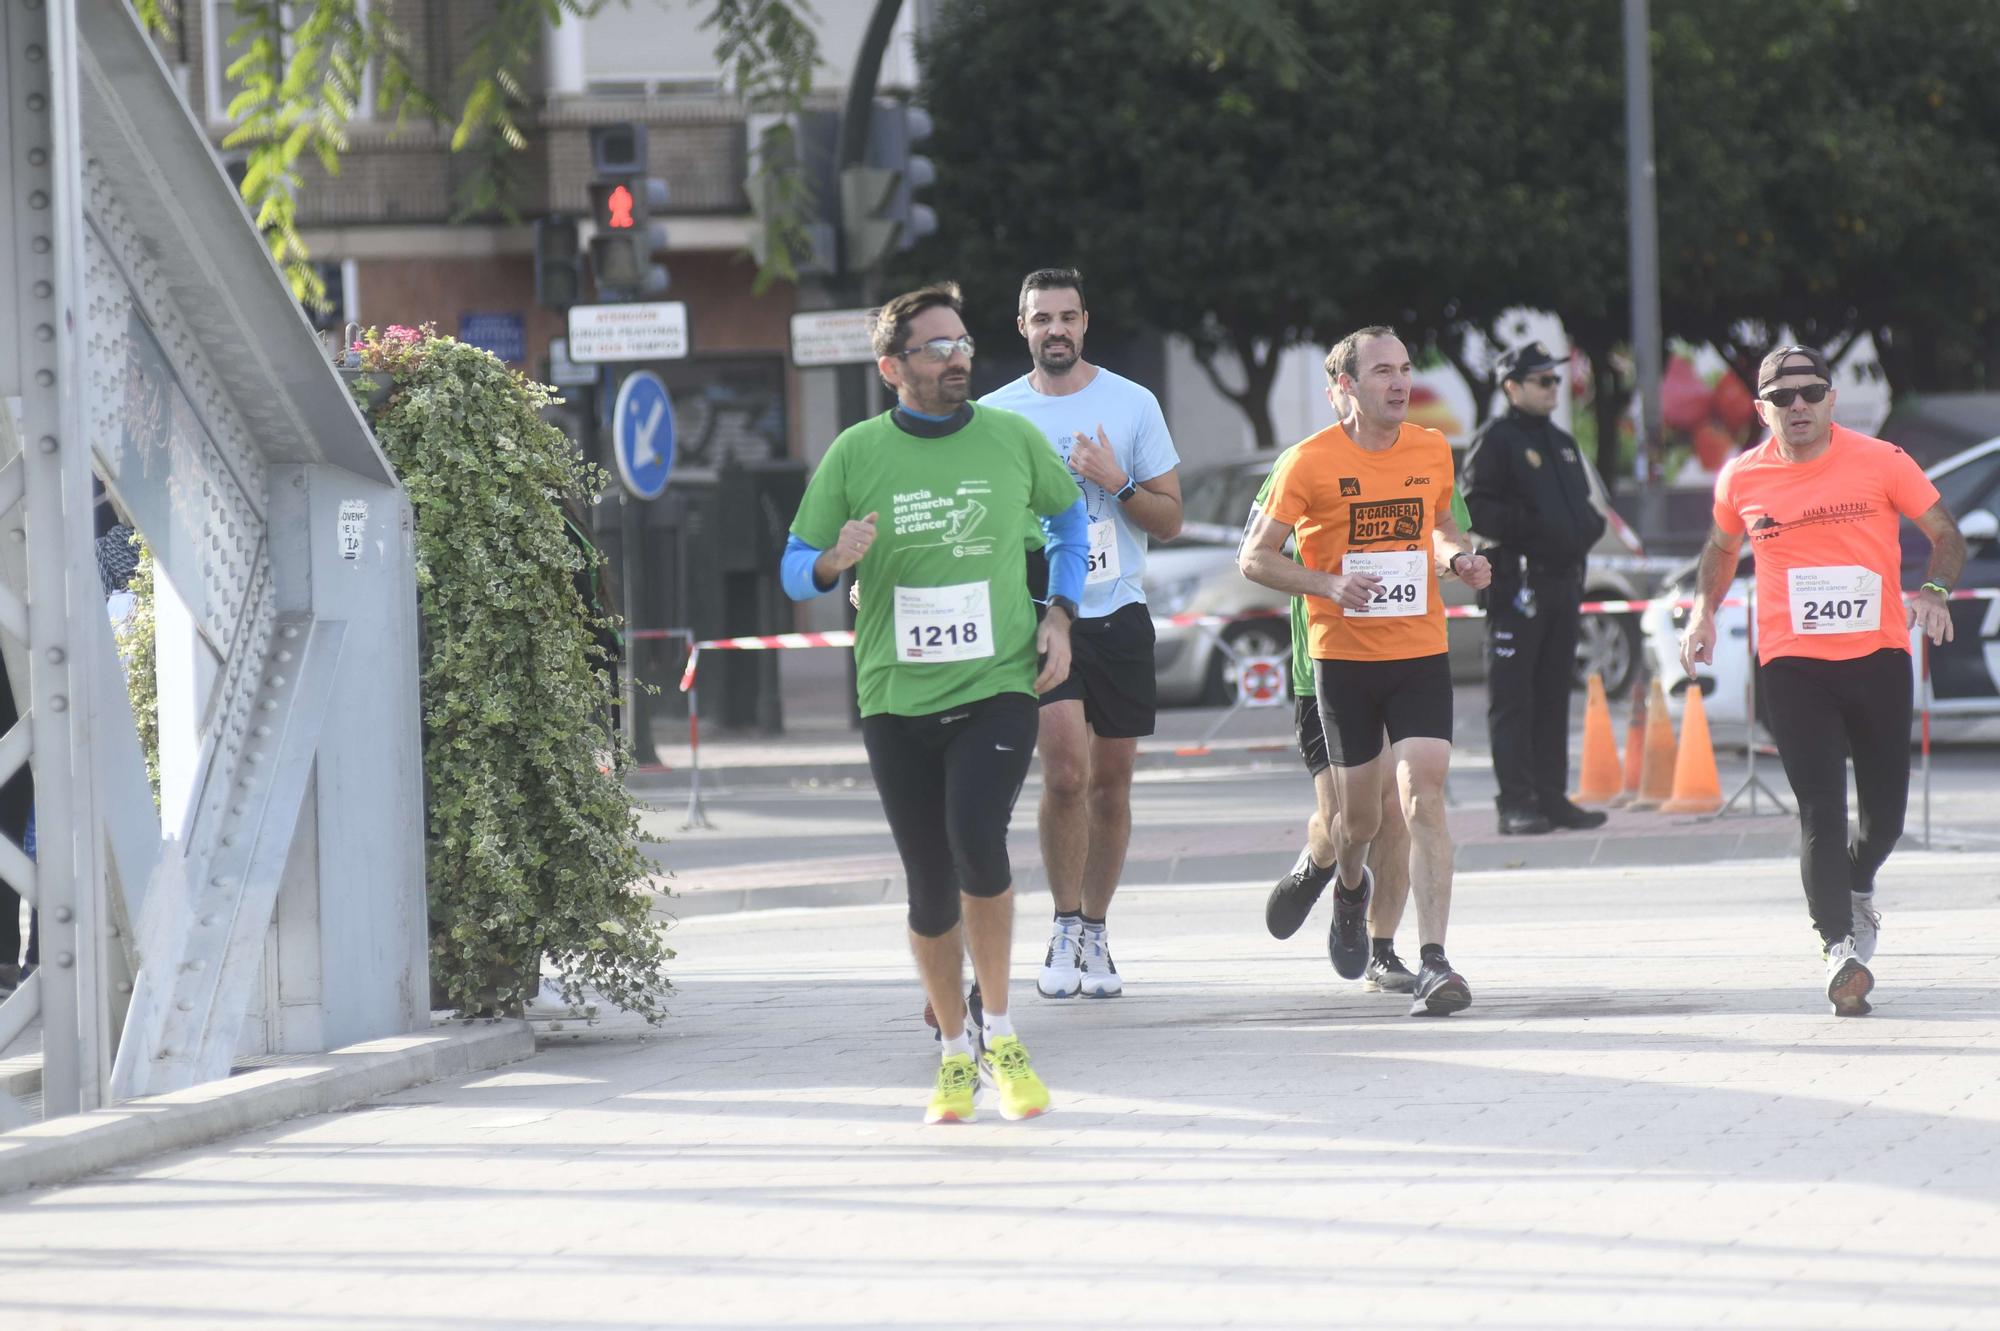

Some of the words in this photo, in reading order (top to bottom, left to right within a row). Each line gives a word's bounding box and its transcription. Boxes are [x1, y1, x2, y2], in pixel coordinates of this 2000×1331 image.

[893, 489, 931, 504] Murcia
[894, 504, 908, 514] en
[910, 497, 954, 511] marcha
[1367, 505, 1418, 520] CARRERA
[894, 511, 932, 524] contra
[895, 524, 907, 535] el
[907, 519, 948, 533] cáncer
[1356, 521, 1390, 537] 2012
[1363, 584, 1416, 604] 249
[1804, 599, 1868, 620] 2407
[909, 622, 978, 647] 1218
